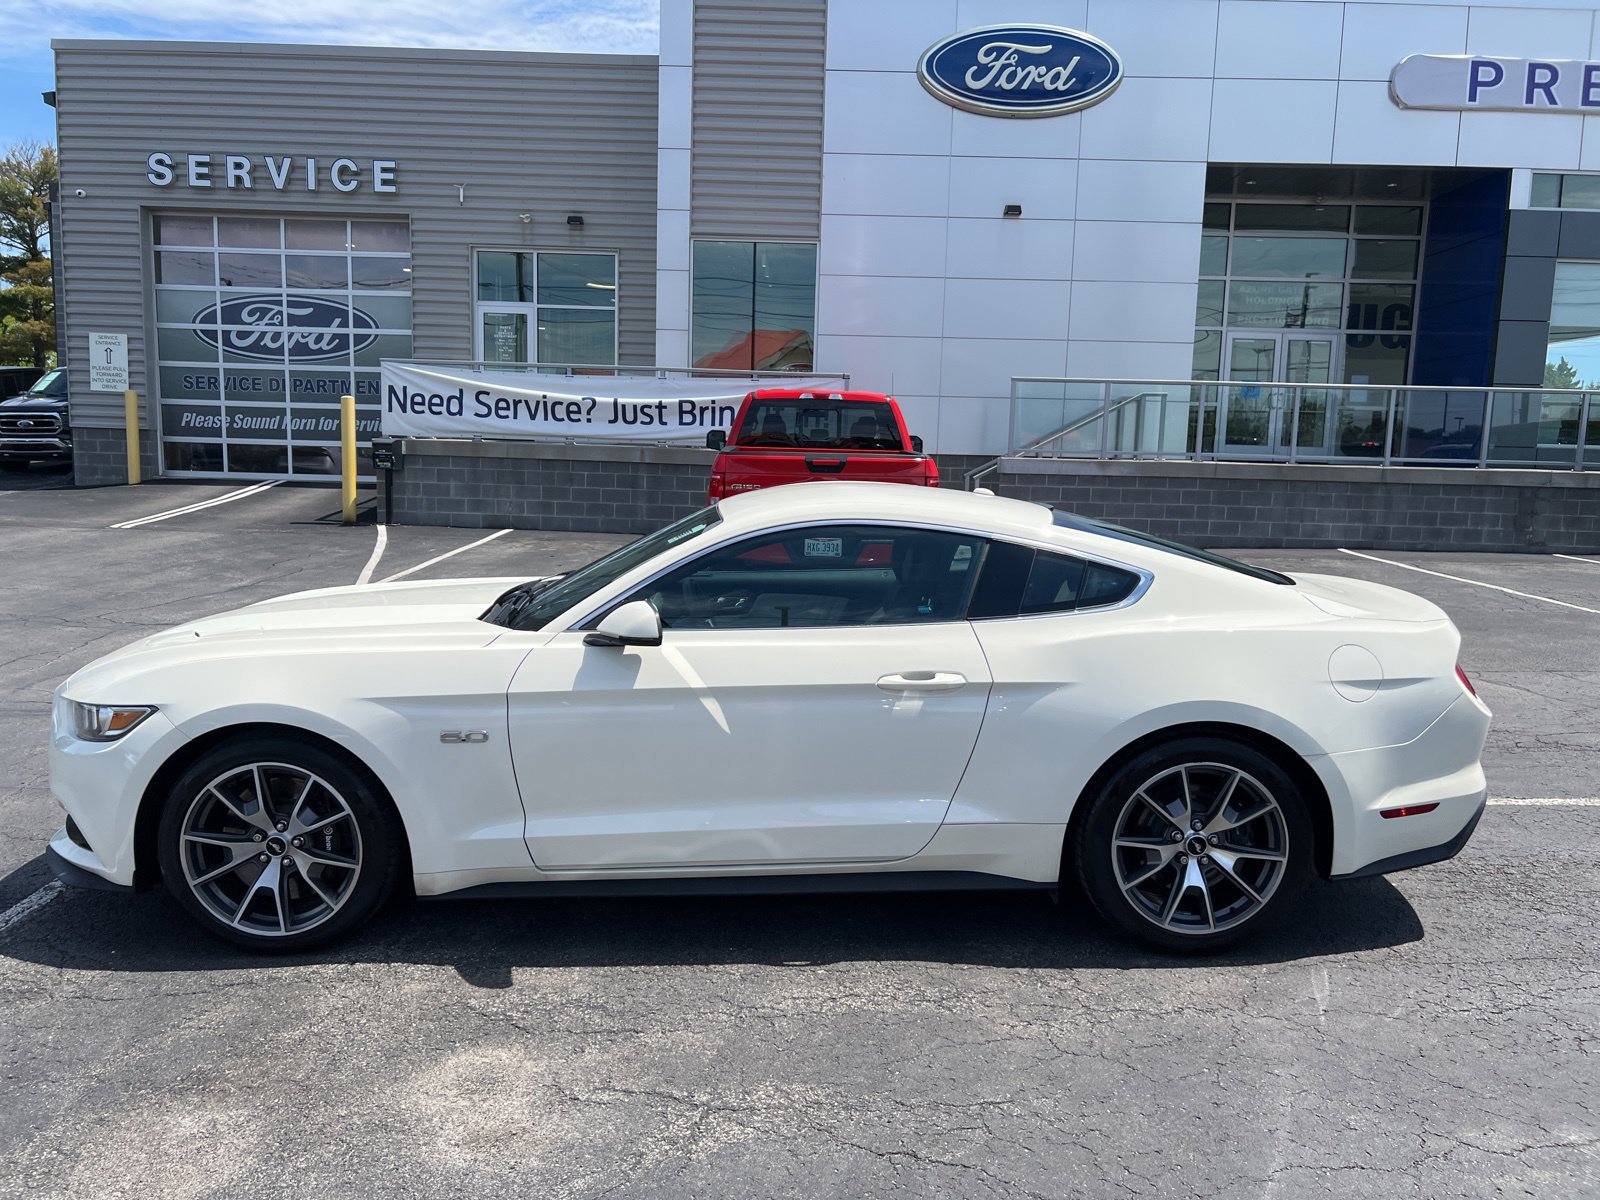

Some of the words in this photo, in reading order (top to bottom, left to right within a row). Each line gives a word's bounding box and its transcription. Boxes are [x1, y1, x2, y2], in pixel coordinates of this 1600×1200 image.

[965, 42, 1080, 91] Ford
[147, 152, 397, 193] SERVICE
[230, 304, 342, 351] Ford
[183, 375, 262, 392] SERVICE
[268, 377, 380, 395] DEPARTMEN
[387, 385, 464, 417] Need
[473, 391, 597, 425] Service?
[608, 398, 668, 426] Just
[678, 399, 736, 427] Brin
[181, 412, 231, 428] Please
[233, 414, 280, 430] Sound
[318, 417, 340, 431] for
[822, 543, 839, 552] 3934
[440, 730, 489, 744] 5.0
